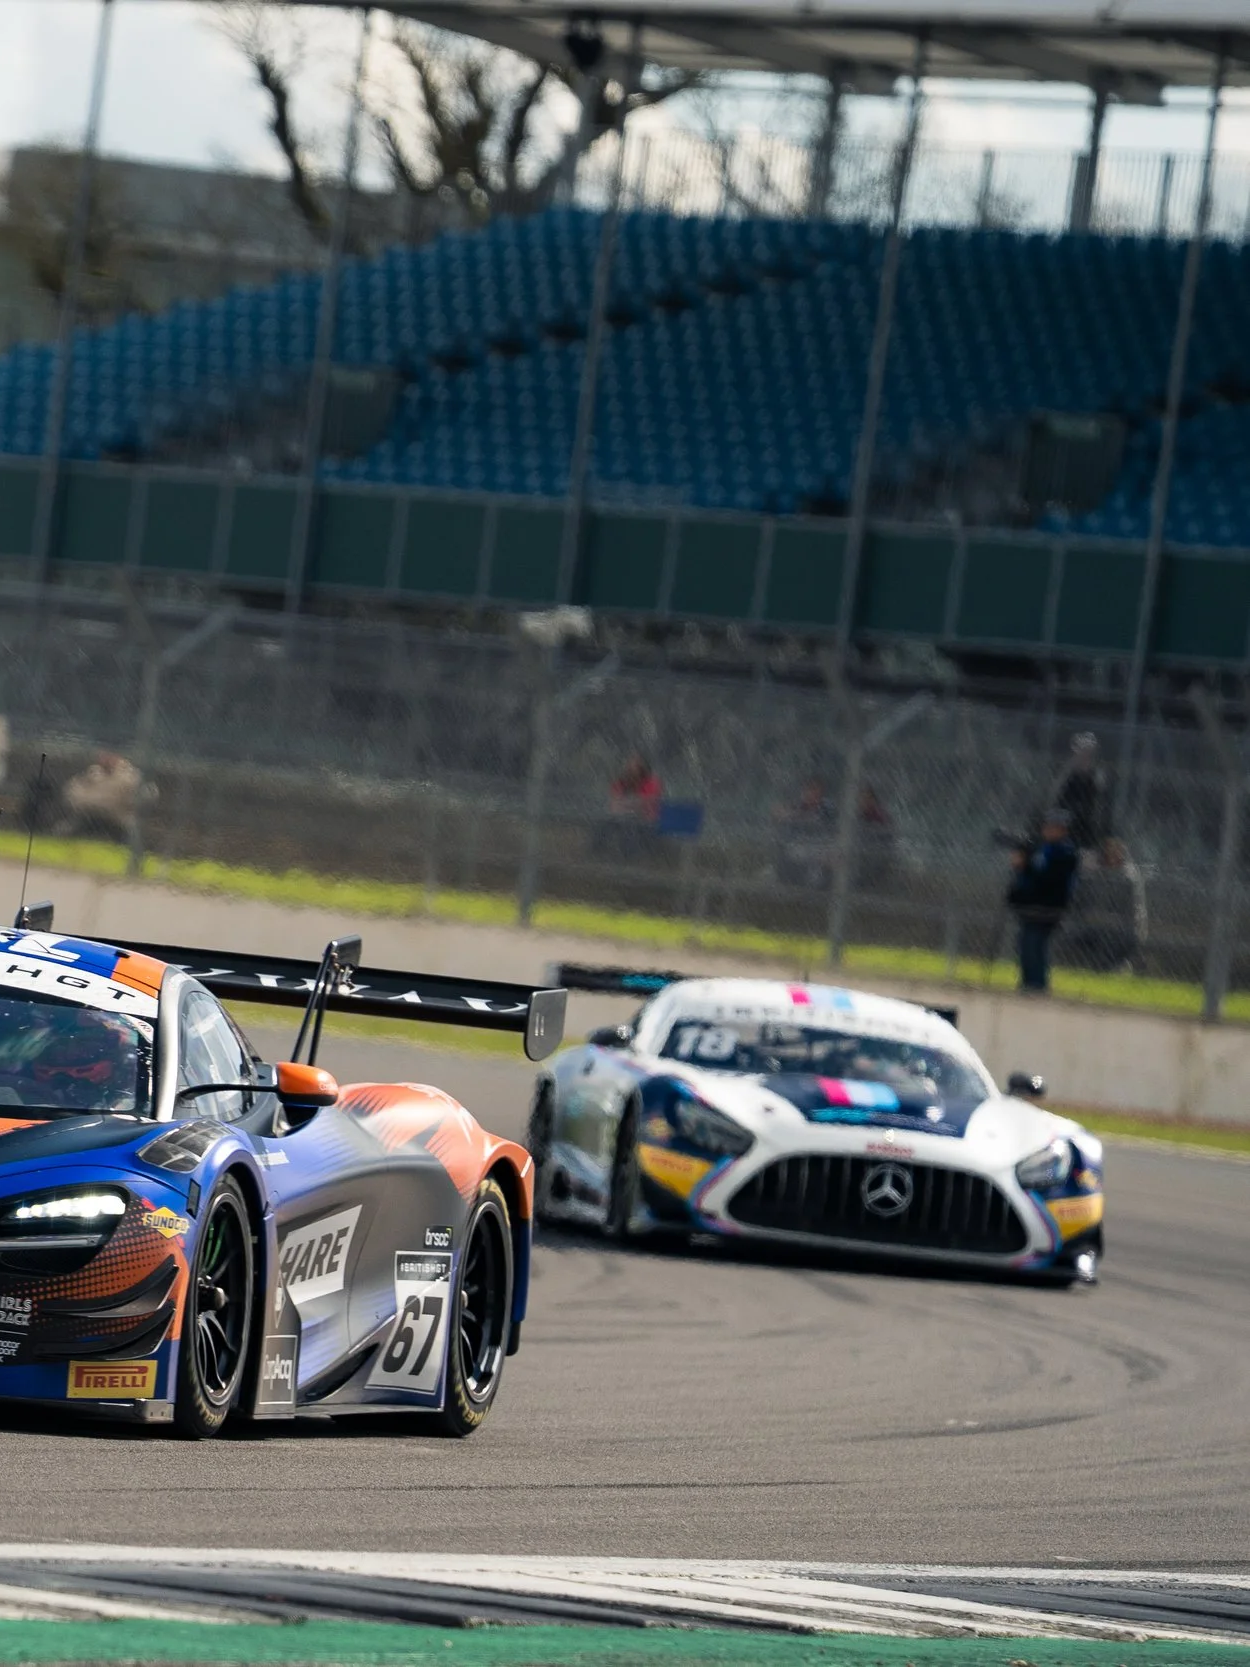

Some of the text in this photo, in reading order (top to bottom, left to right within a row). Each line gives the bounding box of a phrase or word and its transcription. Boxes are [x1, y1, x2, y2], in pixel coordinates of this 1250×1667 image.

[144, 1213, 189, 1233] SUNOCO
[424, 1227, 450, 1247] brscc
[280, 1225, 351, 1286] HARE
[382, 1294, 444, 1377] 67
[73, 1365, 149, 1389] PIRELLI
